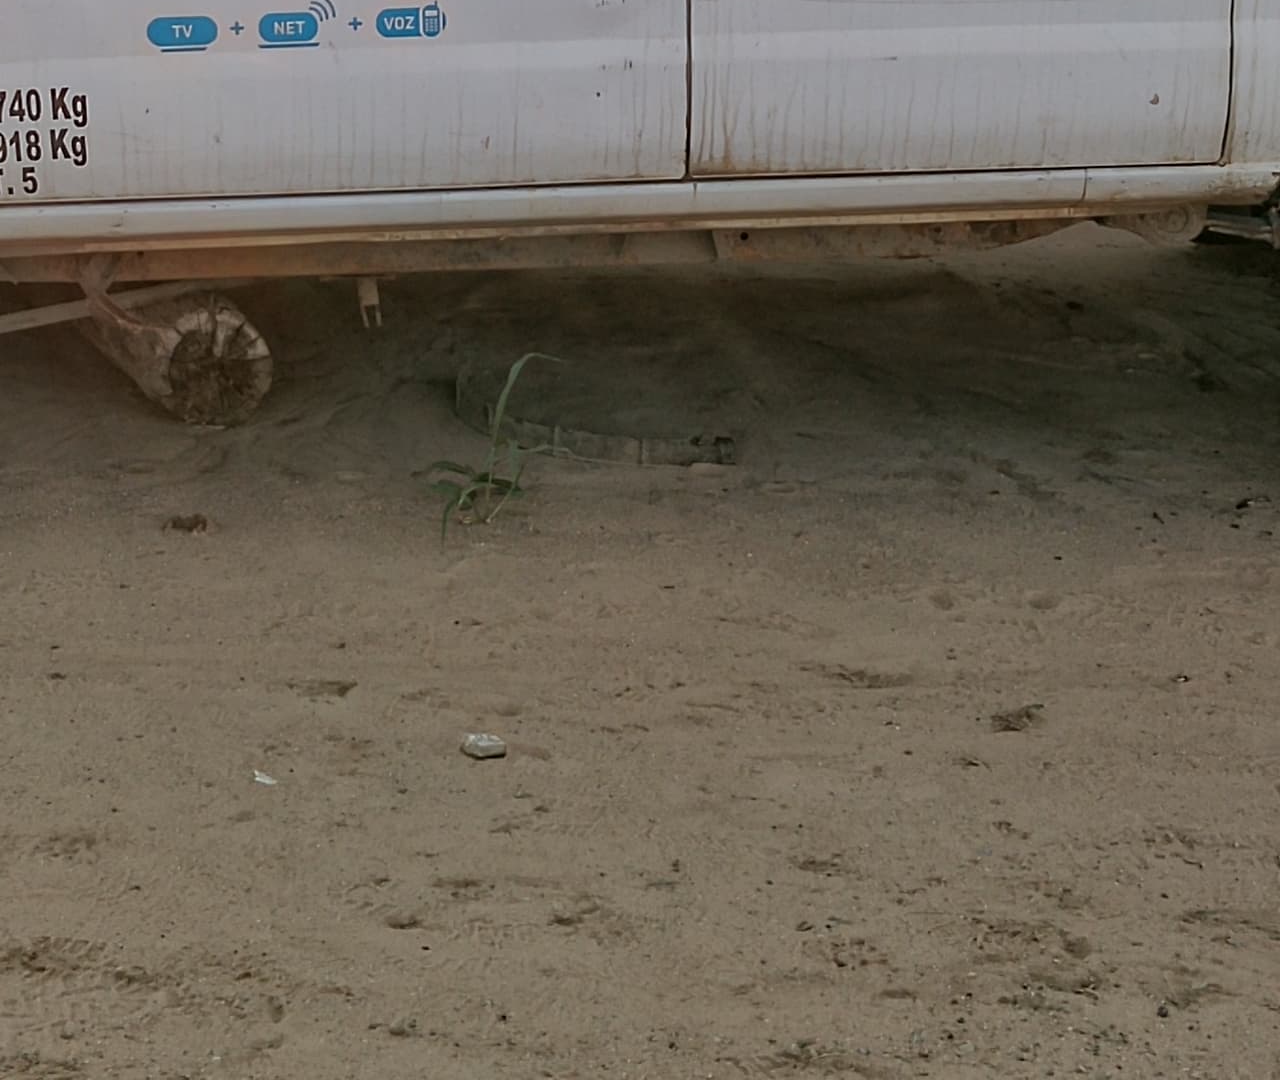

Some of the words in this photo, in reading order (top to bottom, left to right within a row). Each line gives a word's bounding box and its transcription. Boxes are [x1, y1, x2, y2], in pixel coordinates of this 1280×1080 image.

[172, 24, 193, 39] TV
[273, 20, 307, 36] NET
[383, 16, 416, 31] VOZ
[50, 87, 88, 128] Kg
[50, 128, 88, 167] Kg
[22, 166, 39, 194] 5
